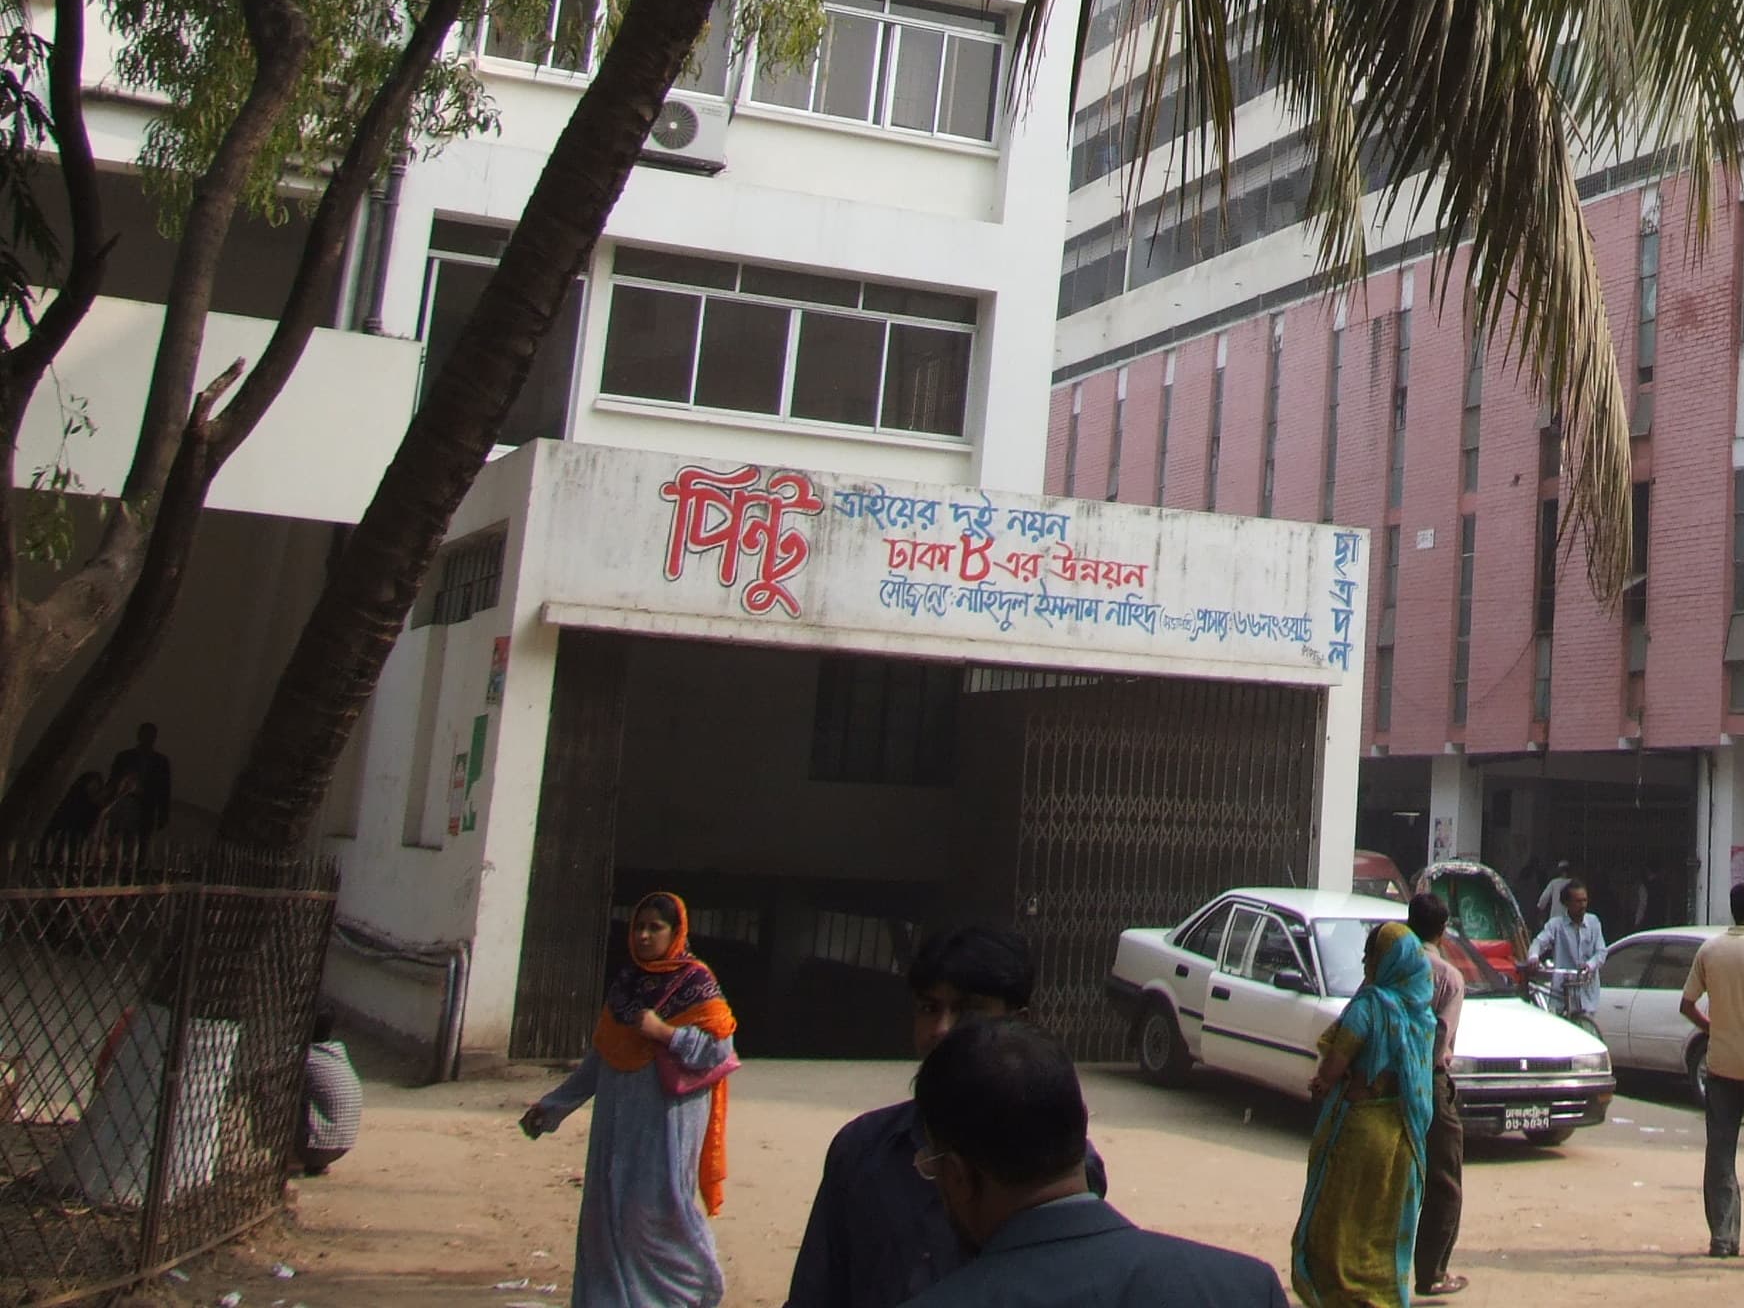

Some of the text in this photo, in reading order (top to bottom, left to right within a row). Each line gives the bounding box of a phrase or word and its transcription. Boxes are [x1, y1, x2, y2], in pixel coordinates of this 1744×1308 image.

[659, 464, 1071, 619] পিন্টু ভাইয়ের দুই নয়ন
[883, 538, 957, 573] ঢাকা
[1050, 541, 1149, 590] উন্নয়ন
[955, 580, 1033, 632] নাহিদুল
[1034, 579, 1104, 629] ইসলাম
[1105, 592, 1162, 636] নাহিদ
